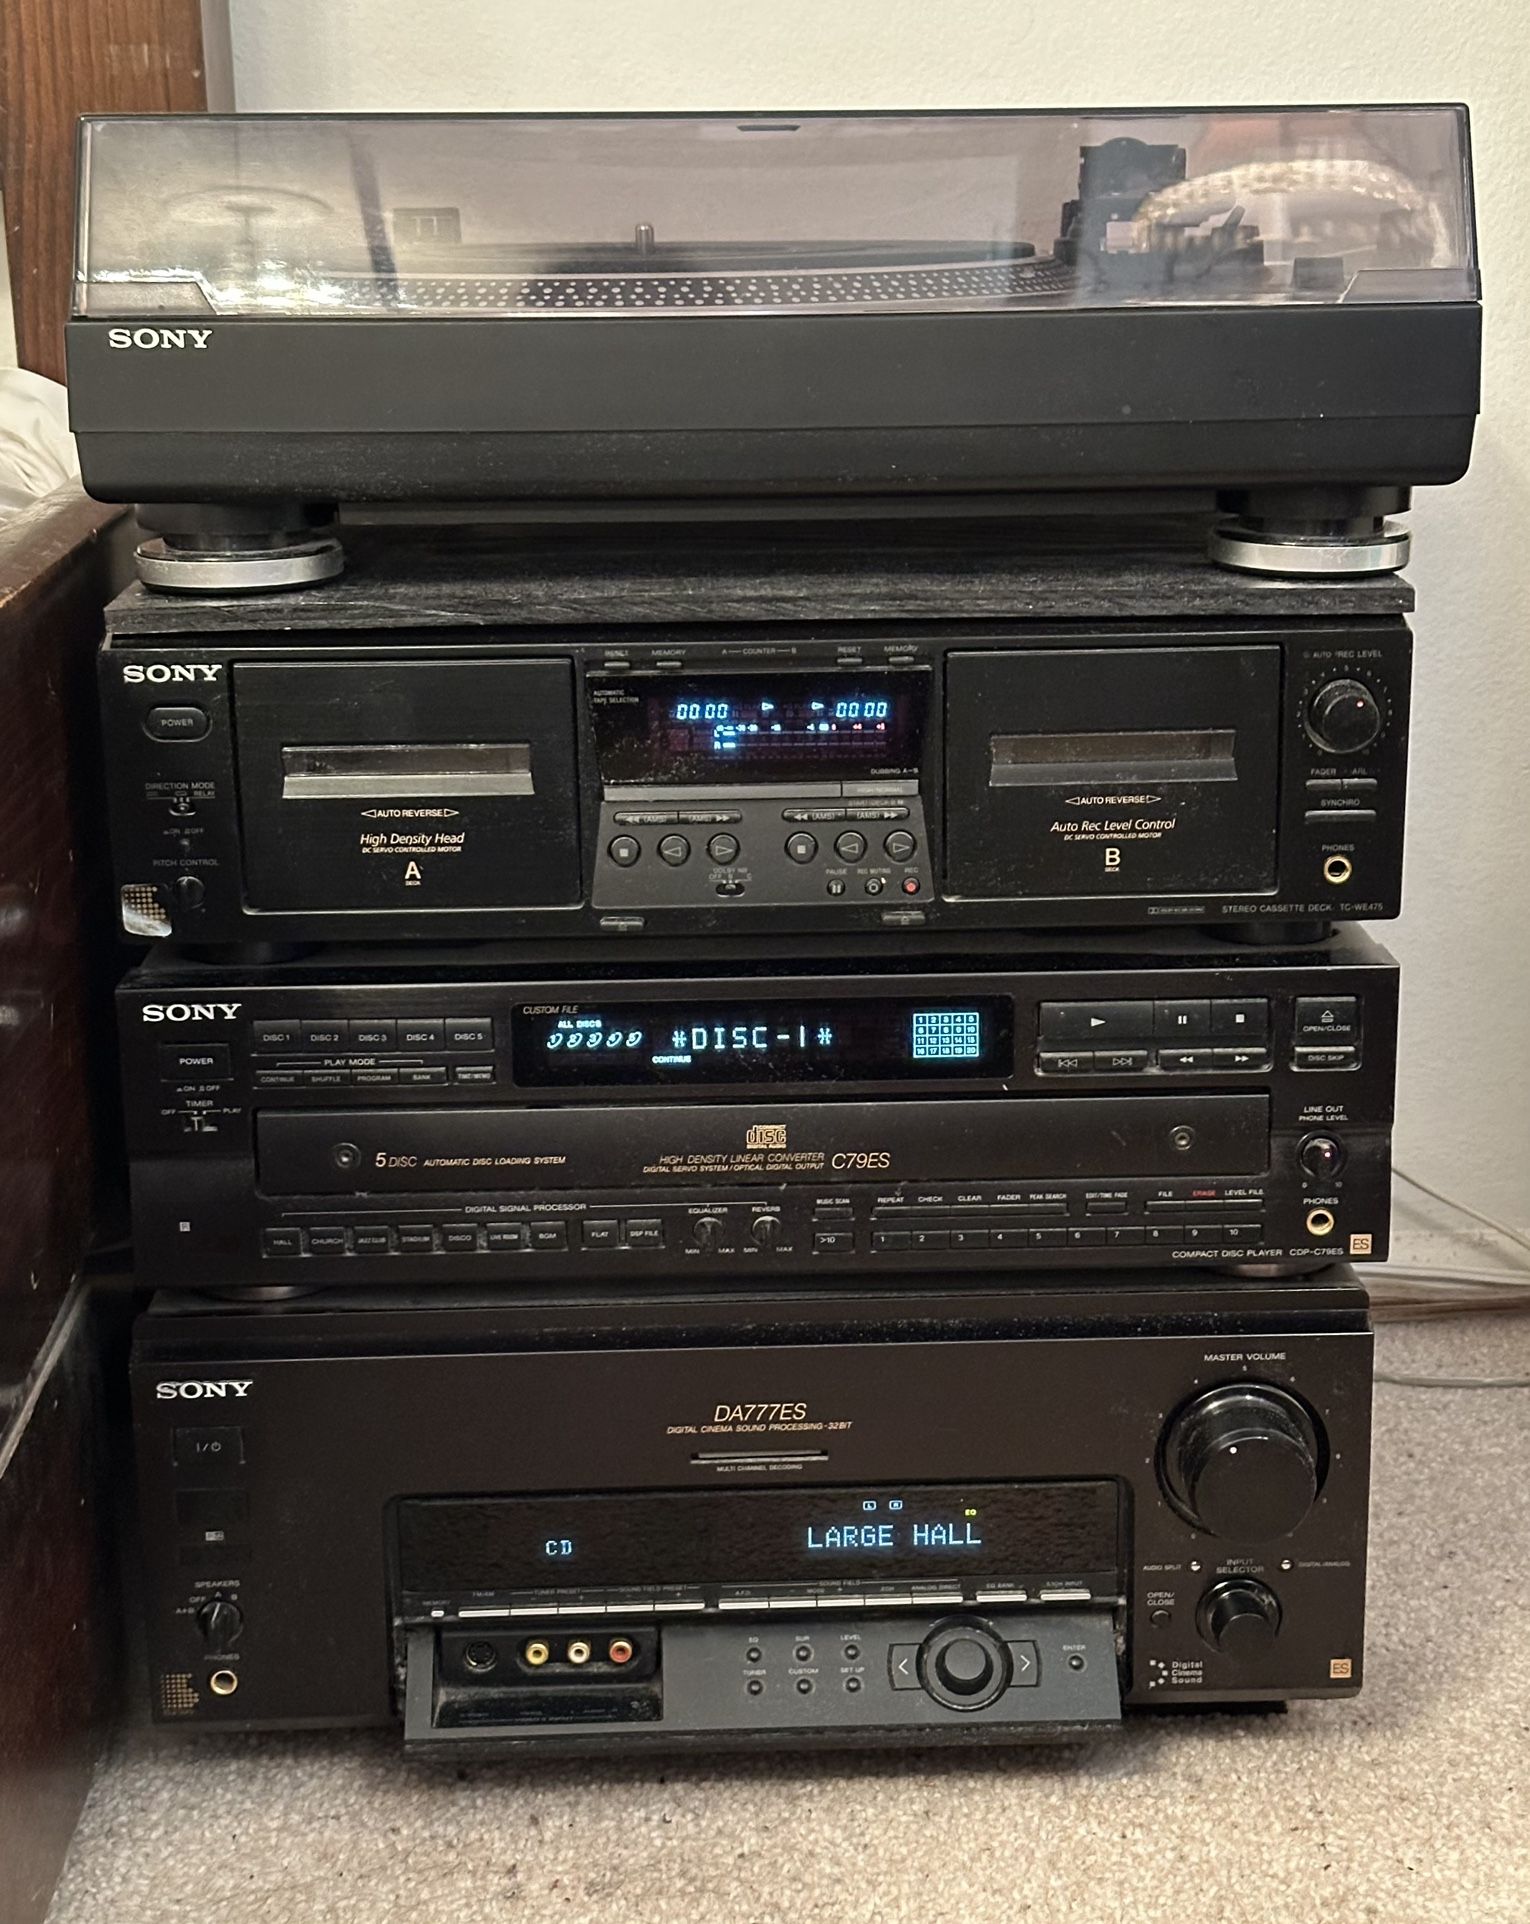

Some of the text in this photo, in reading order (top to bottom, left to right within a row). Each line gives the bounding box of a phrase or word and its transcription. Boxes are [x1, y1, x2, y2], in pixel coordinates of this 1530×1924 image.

[108, 329, 213, 350] SONY
[122, 663, 223, 684] SONY
[161, 718, 194, 727] POWER
[144, 781, 216, 790] DIRECTION MODE
[1080, 795, 1146, 805] AUTO REVERSE
[1320, 798, 1361, 807] SYNCHRO
[376, 808, 444, 818] AUTO REVERSE
[1050, 817, 1177, 833] Auto Rec Level Control
[360, 831, 466, 847] High Density Head
[1074, 833, 1095, 841] SERVO
[1095, 832, 1137, 840] CONTROLLED
[373, 845, 462, 854] SERVO CONTROLLED MOTOR
[1321, 843, 1355, 852] PHONES
[1104, 847, 1121, 866] B
[152, 858, 219, 867] PITCH CONTROL
[404, 860, 422, 880] A
[904, 866, 919, 874] REC
[1221, 902, 1383, 913] STEREO CASSETTE DECK TC-WE475
[142, 1003, 243, 1022] SONY
[522, 1005, 579, 1015] CUSTOM FILE
[557, 1019, 602, 1029] ALL DISCS
[1302, 1024, 1351, 1033] OPEN/CLOSE
[263, 1034, 285, 1042] DISC
[310, 1034, 333, 1042] DISC
[358, 1033, 380, 1041] DISC
[406, 1033, 429, 1041] DISC
[454, 1032, 476, 1040] DISC
[178, 1057, 214, 1065] POWER
[324, 1058, 376, 1066] PLAY MODE
[651, 1055, 691, 1064] CONTINUE
[160, 1108, 177, 1116] OFF
[1303, 1105, 1344, 1113] LINE OUT
[375, 1152, 566, 1168] 5 DISC AUTOMATIC DISC LOADING SYSTEM
[659, 1152, 825, 1164] HIGH DENSITY LINEAR CONVERTER
[831, 1152, 891, 1170] C79ES
[643, 1162, 825, 1174] DIGITAL SERVO DIGITAL OUTPUT
[1157, 1190, 1173, 1198] FILE
[1248, 1188, 1265, 1196] FILE
[877, 1196, 905, 1204] REPEAT
[1302, 1197, 1339, 1205] PHONES
[464, 1203, 587, 1214] DIGITAL SIGNAL PROCESSOR
[687, 1206, 729, 1215] EQUALIZER
[629, 1229, 660, 1238] DSP FILE
[1152, 1230, 1159, 1238] 8
[1191, 1229, 1198, 1237] 9
[1229, 1228, 1239, 1236] 10
[1352, 1238, 1370, 1250] ES
[1171, 1248, 1344, 1259] COMPACT DISC PLAYER CDP-C79ES
[1204, 1352, 1287, 1362] MASTER VOLUME
[155, 1380, 254, 1400] SONY
[713, 1402, 808, 1423] DA777ES
[665, 1423, 766, 1435] DIGITAL CINEMA SOUND
[964, 1508, 977, 1516] EQ
[807, 1522, 982, 1548] LARGE HALL
[545, 1539, 572, 1556] CD
[1226, 1558, 1254, 1566] INPUT
[1164, 1563, 1182, 1571] SPLIT
[1215, 1565, 1265, 1574] SELECTOR
[194, 1579, 241, 1588] SPEAKERS
[1146, 1591, 1176, 1599] OPEN/
[188, 1596, 207, 1604] OFF
[1146, 1598, 1175, 1606] CLOSE
[203, 1653, 241, 1661] PHONES
[1171, 1660, 1204, 1670] Digital
[1333, 1663, 1350, 1674] ES
[742, 1668, 767, 1676] TUNER
[1171, 1669, 1204, 1677] Cinema
[1171, 1676, 1203, 1684] Sound
